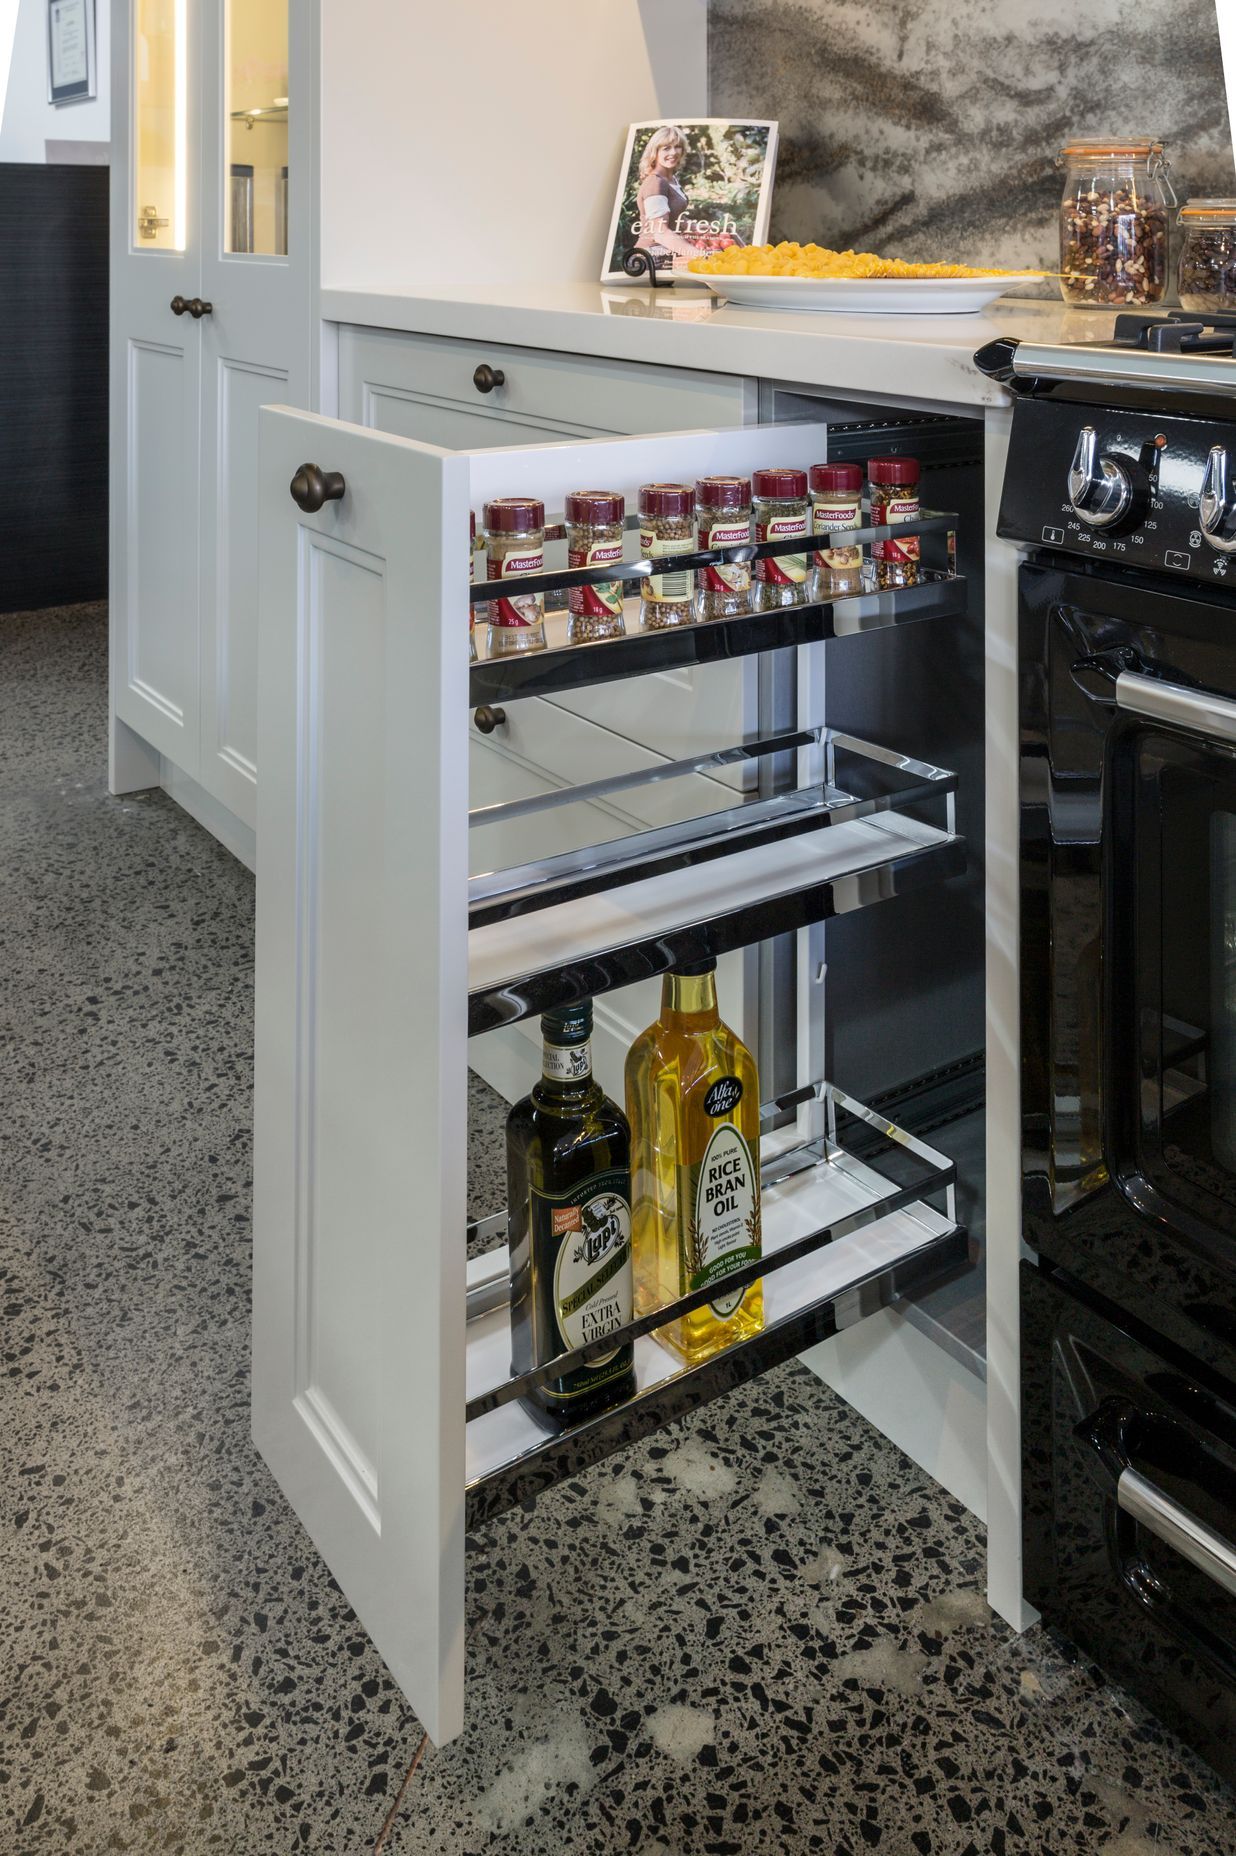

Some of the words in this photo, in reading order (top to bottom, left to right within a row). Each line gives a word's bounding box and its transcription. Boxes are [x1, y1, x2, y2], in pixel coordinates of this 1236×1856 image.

[630, 217, 668, 235] eat
[674, 211, 738, 235] fresh
[1148, 474, 1158, 482] 50
[1061, 503, 1074, 513] 260
[1150, 501, 1164, 510] 100
[815, 509, 855, 520] MasterFoods
[1067, 521, 1081, 531] 245
[1144, 521, 1158, 530] 125
[1077, 533, 1091, 542] 225
[1092, 541, 1106, 550] 200
[1131, 535, 1144, 545] 150
[1113, 542, 1126, 551] 175
[706, 1082, 733, 1104] Alfa
[710, 1098, 733, 1115] one
[723, 1146, 738, 1157] PURE
[709, 1157, 742, 1184] RICE
[706, 1173, 746, 1203] BRAN
[713, 1195, 739, 1217] OIL
[585, 1220, 617, 1266] Lupi
[709, 1260, 724, 1274] GOOD
[724, 1255, 735, 1265] FOR
[735, 1251, 747, 1260] YOU
[716, 1268, 726, 1278] FOR
[726, 1261, 741, 1271] YOUR
[562, 1283, 594, 1315] SPECIAL
[581, 1300, 621, 1329] EXTRA
[582, 1315, 622, 1345] VIRGIN
